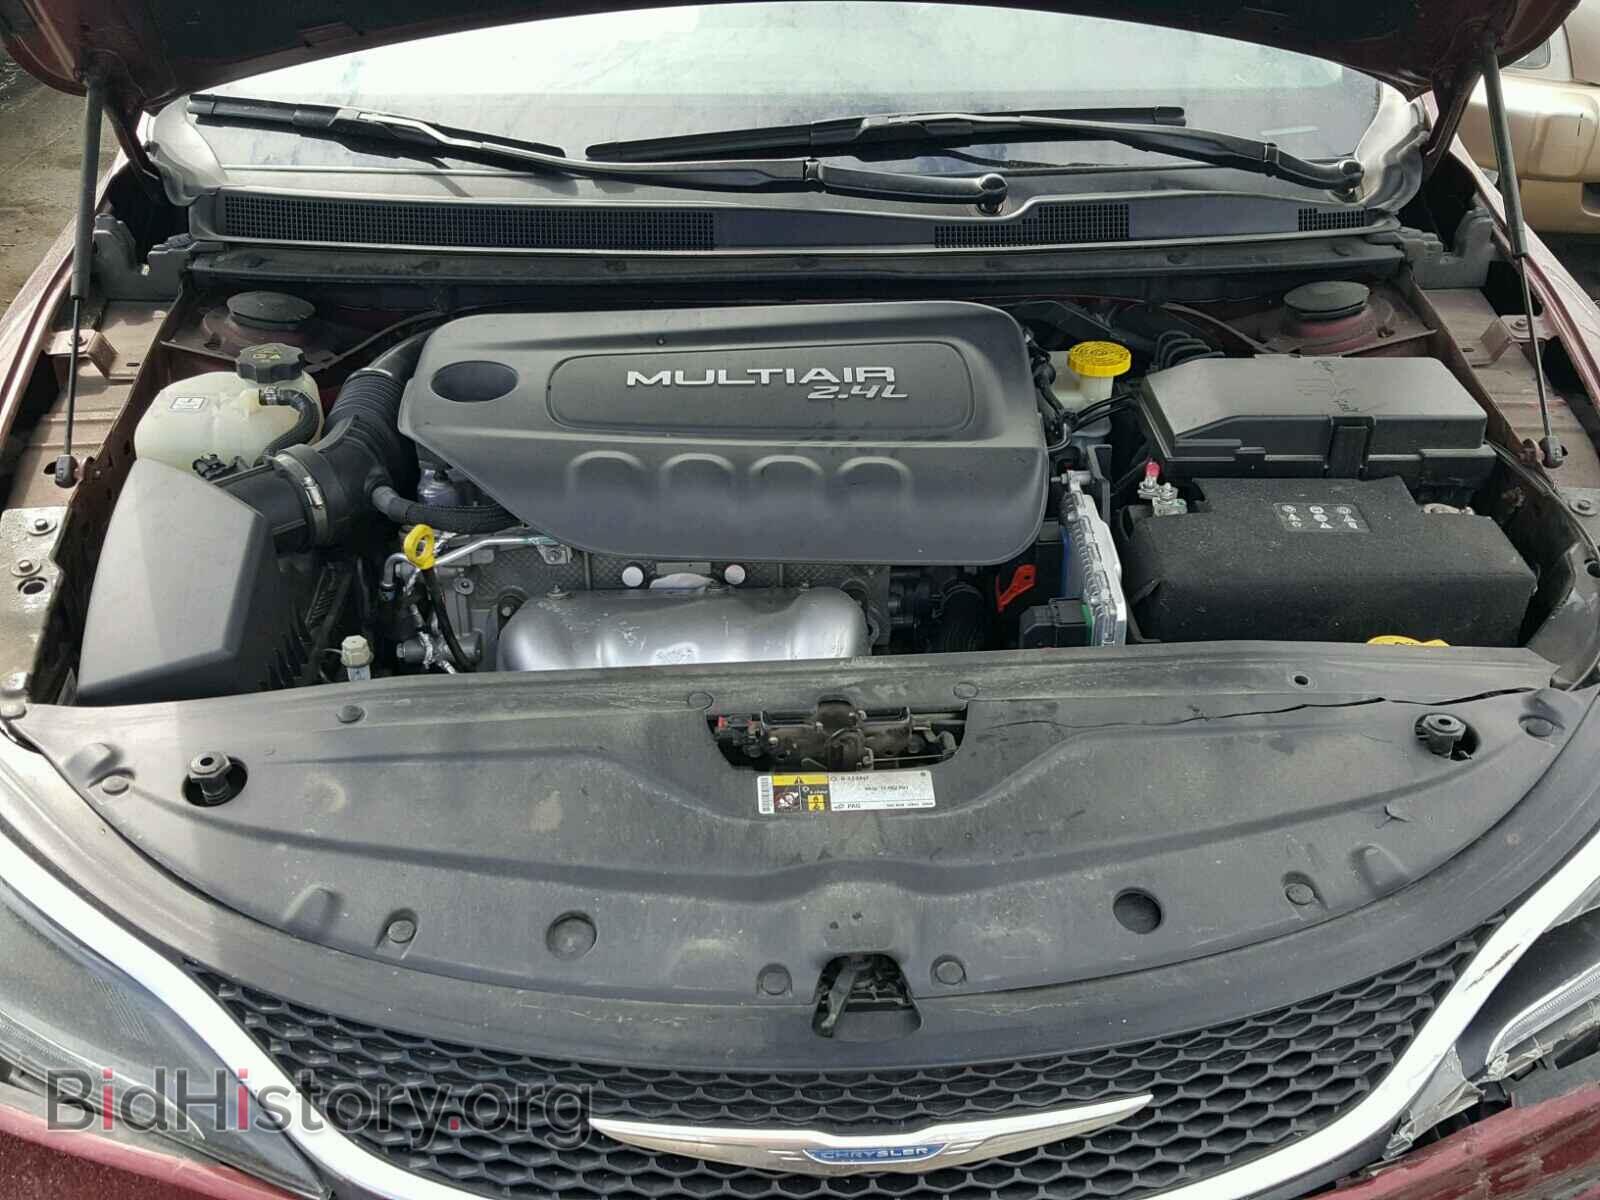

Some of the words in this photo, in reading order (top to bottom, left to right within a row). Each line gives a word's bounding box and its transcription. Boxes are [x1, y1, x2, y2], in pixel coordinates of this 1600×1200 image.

[626, 366, 896, 386] MULTIAIR
[807, 385, 908, 399] 2.4L
[820, 1147, 929, 1159] CHRYSLER
